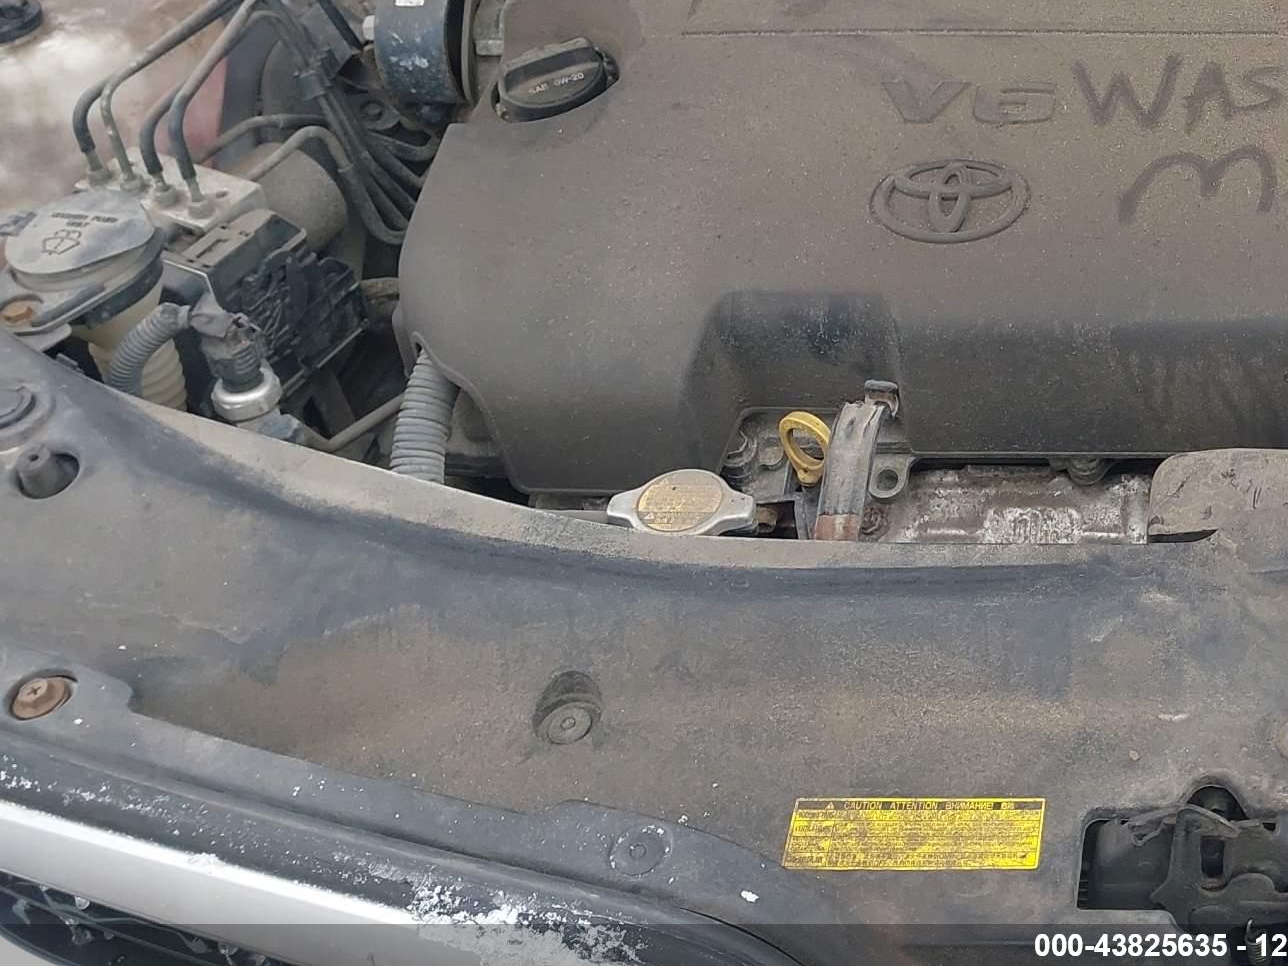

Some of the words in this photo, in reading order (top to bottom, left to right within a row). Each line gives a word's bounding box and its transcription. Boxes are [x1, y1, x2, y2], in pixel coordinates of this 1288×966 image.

[881, 81, 1057, 126] V6
[843, 802, 883, 810] CAUTION
[889, 802, 938, 810] ATTENTION
